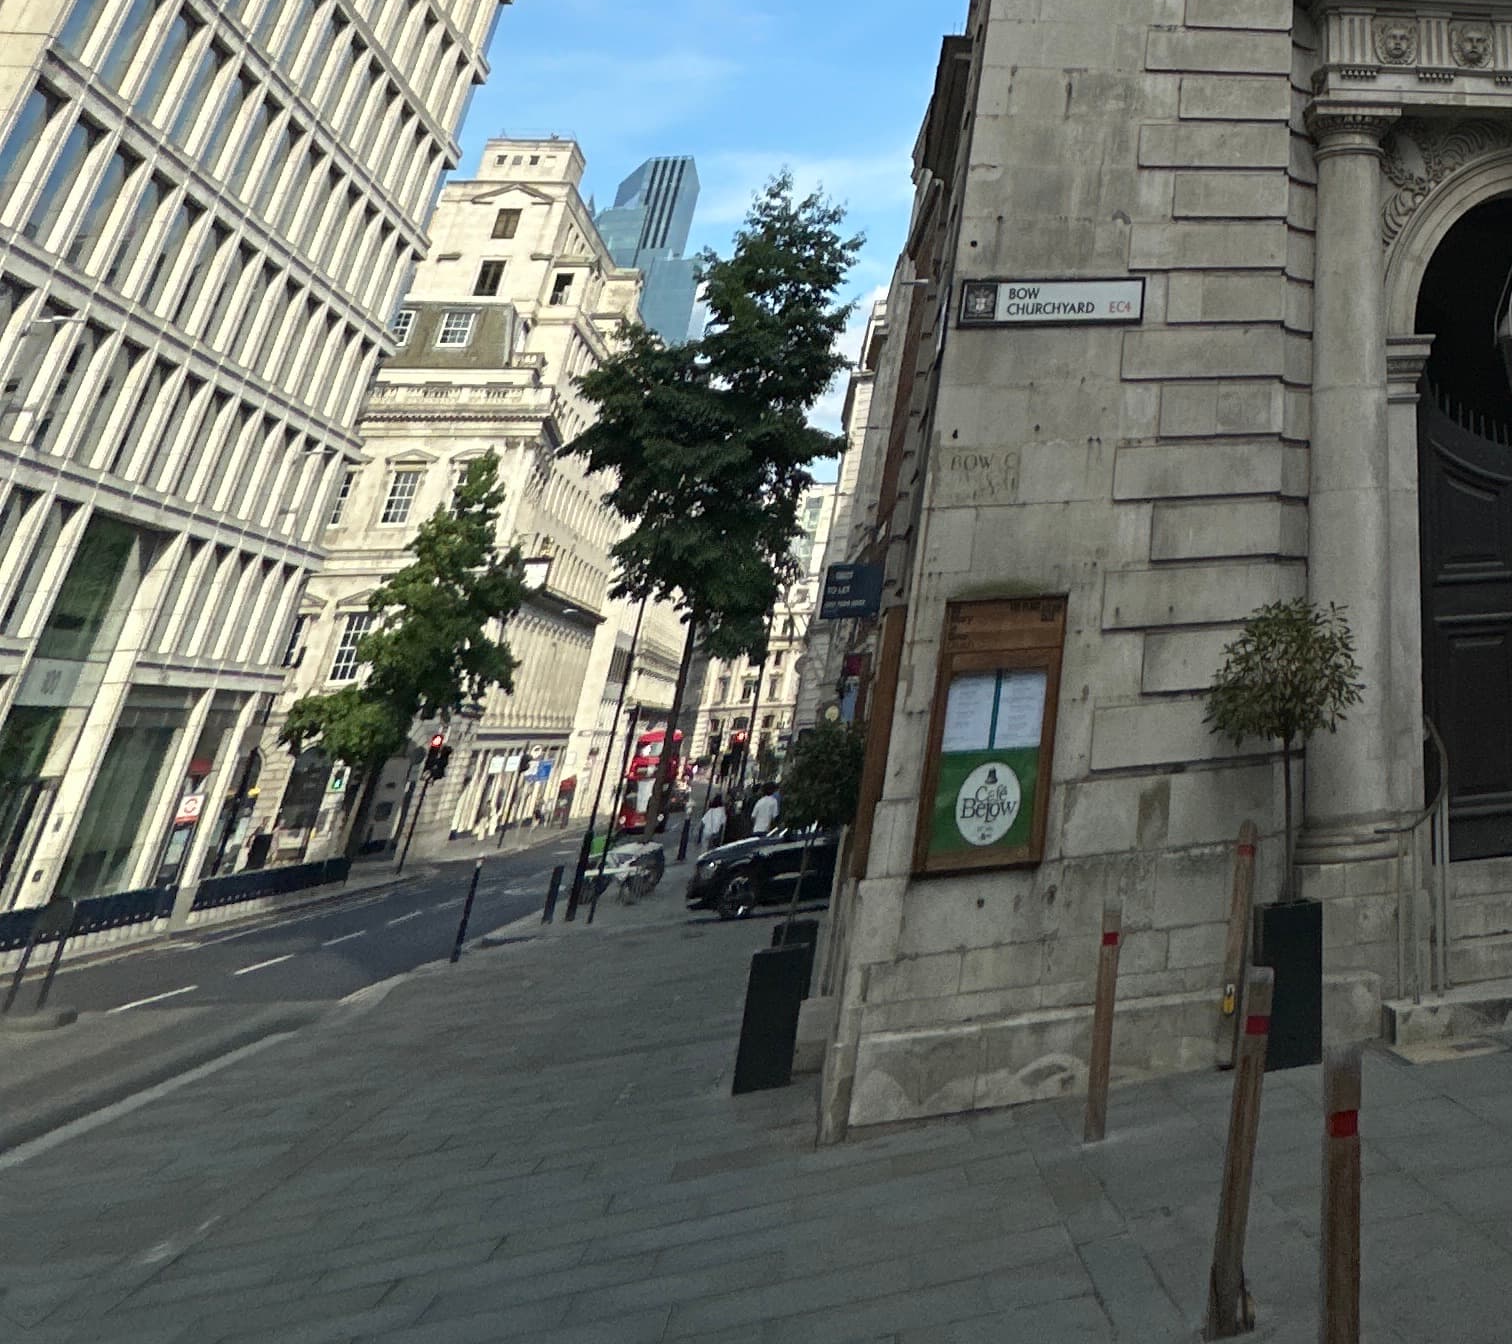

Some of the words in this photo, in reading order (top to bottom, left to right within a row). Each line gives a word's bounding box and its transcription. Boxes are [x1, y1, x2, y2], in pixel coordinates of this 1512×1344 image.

[1008, 287, 1040, 300] BOW
[1006, 301, 1095, 316] CHURCHYARD
[1108, 300, 1132, 313] EC4
[975, 784, 1008, 802] Café
[960, 798, 1017, 823] Below
